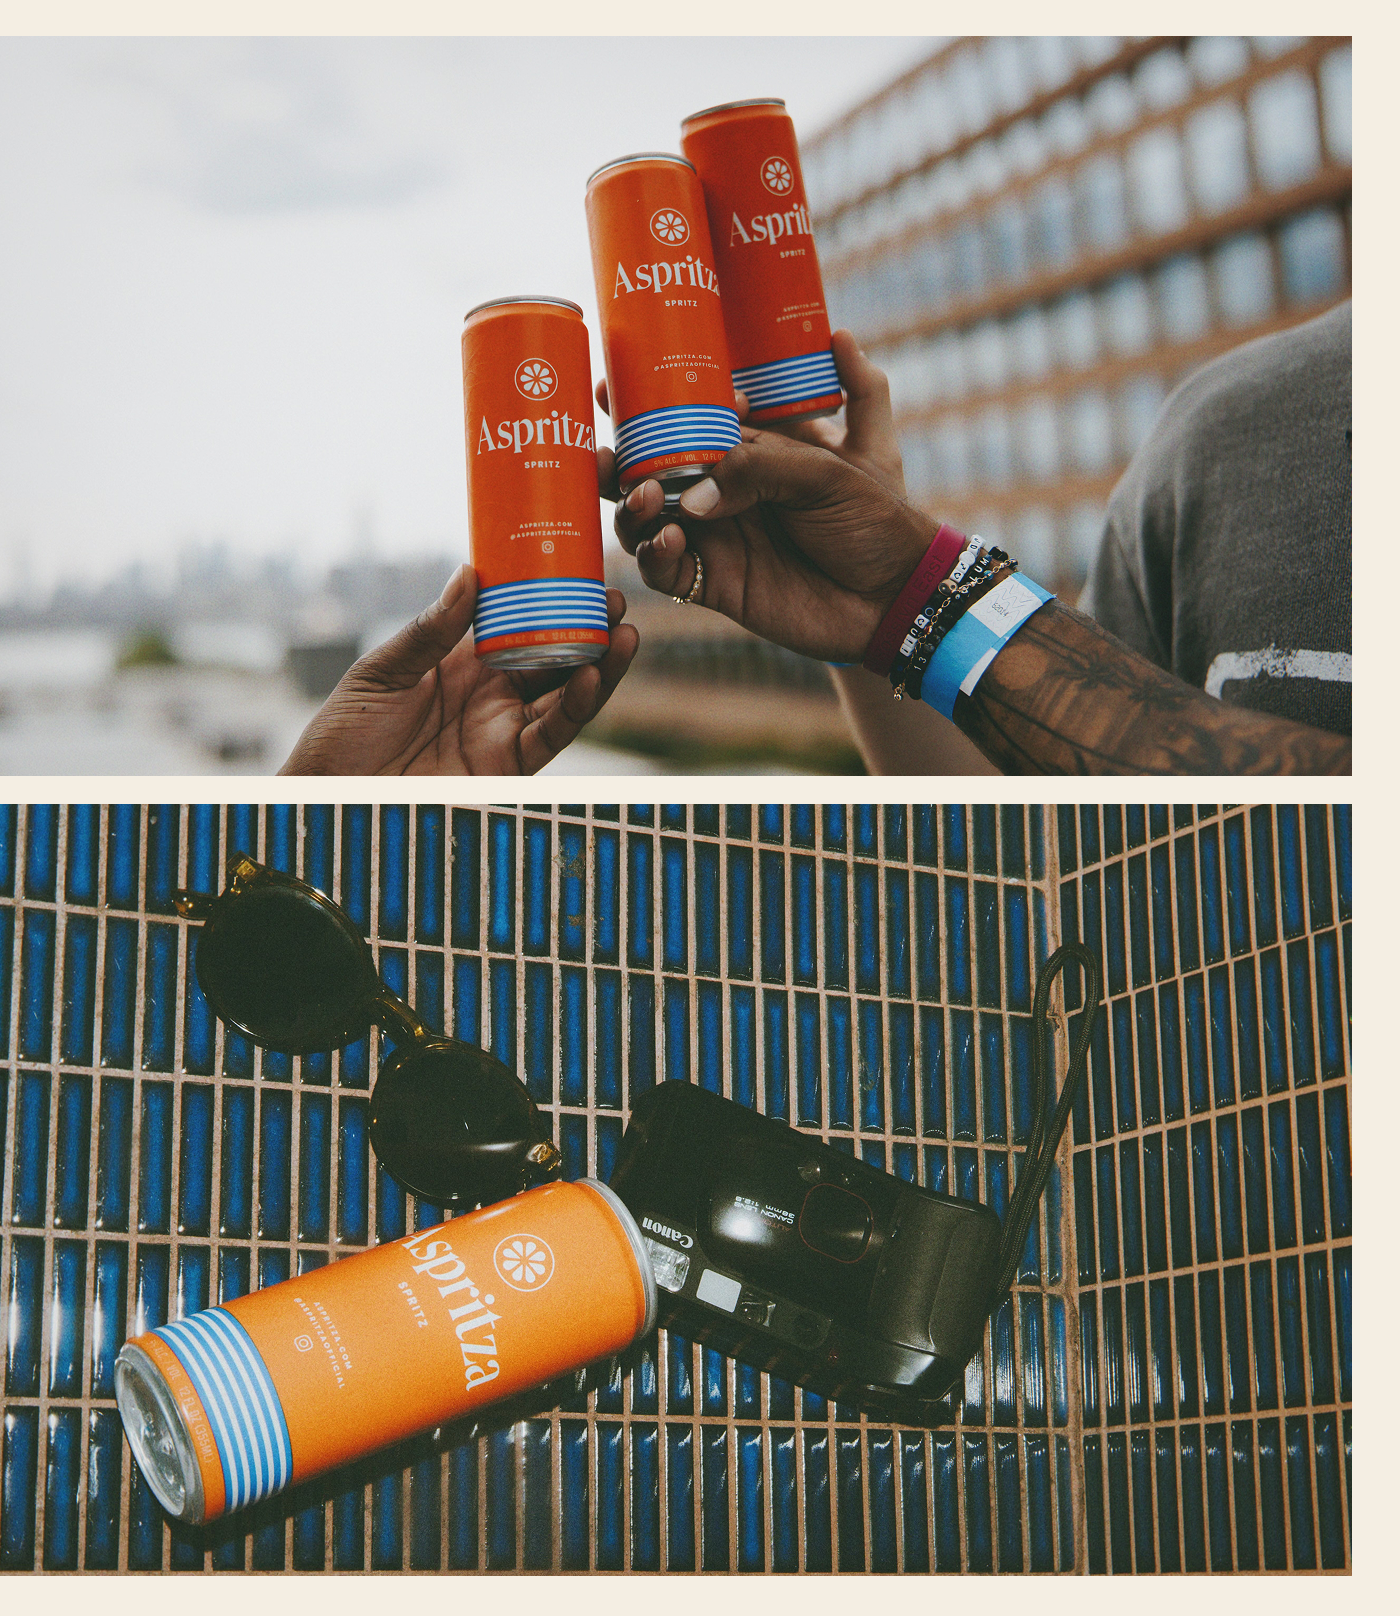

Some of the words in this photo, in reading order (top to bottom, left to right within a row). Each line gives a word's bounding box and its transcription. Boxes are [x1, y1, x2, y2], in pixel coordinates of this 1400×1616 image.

[729, 202, 813, 247] Asprit
[779, 248, 806, 259] SPRITZ
[664, 299, 698, 308] SPRITZ
[653, 361, 720, 372] @ASPRITZAOFFICIAL
[476, 410, 597, 456] Aspritza
[523, 460, 561, 469] SPRITZ
[702, 453, 709, 461] 12
[510, 530, 582, 540] @ASPRITZAOFFICIAL
[519, 521, 573, 529] ASPRITZA.COM
[912, 552, 944, 594] East
[733, 1201, 758, 1213] LENS
[760, 1208, 794, 1225] CANON
[641, 1216, 694, 1249] Canon
[392, 1225, 503, 1392] Aspritza
[397, 1281, 429, 1328] SPRITZ
[293, 1297, 345, 1389] @ASPRITZAOFFICIAL
[313, 1301, 353, 1370] ASPRITZA.COM
[178, 1385, 191, 1398] 12
[194, 1423, 216, 1464] (355ML)
